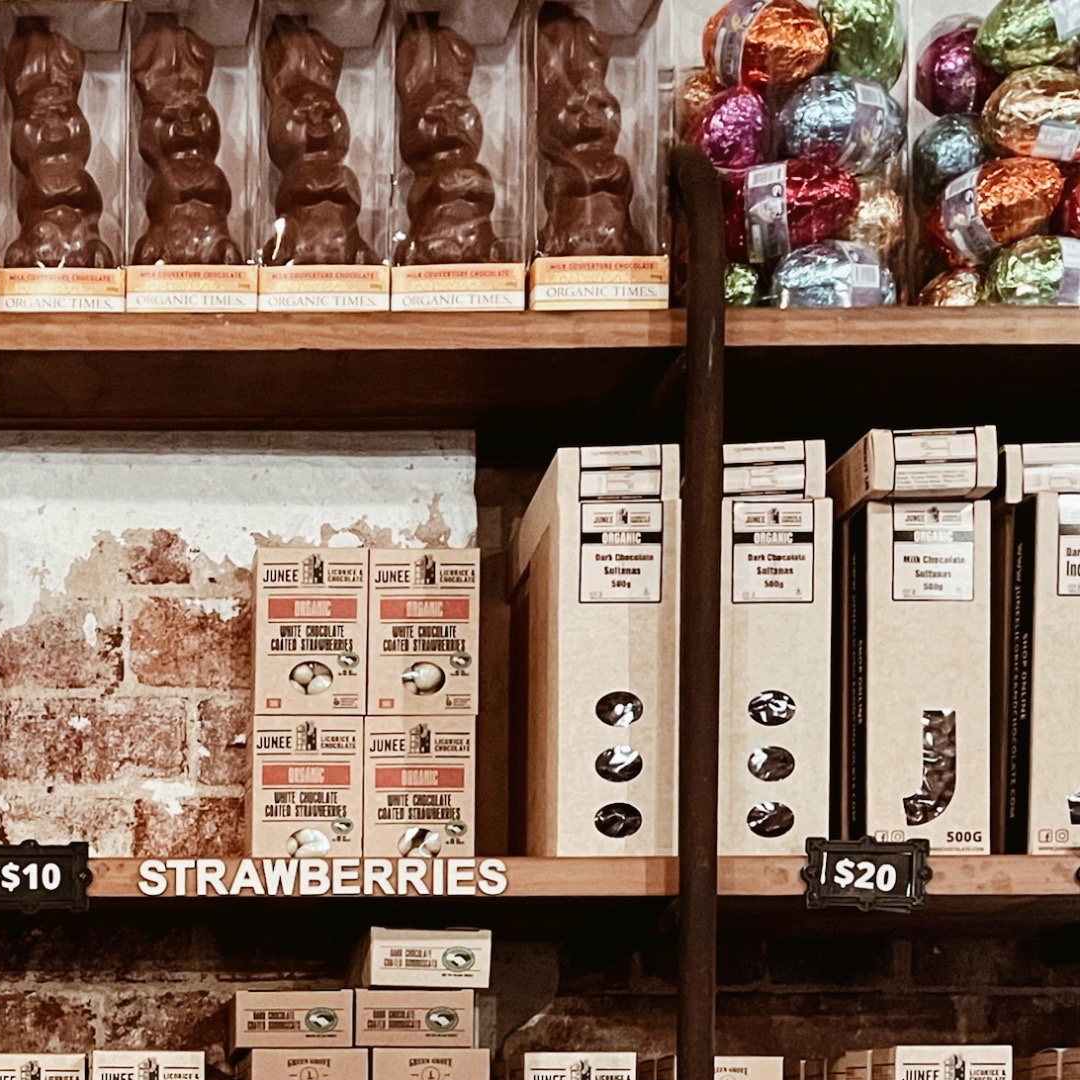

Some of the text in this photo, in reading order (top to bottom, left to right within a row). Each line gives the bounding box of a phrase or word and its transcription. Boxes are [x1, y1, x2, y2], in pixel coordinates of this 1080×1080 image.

[547, 286, 608, 297] ORGANIC
[602, 533, 641, 544] ORGANIC
[754, 532, 793, 544] ORGANIC
[914, 531, 953, 543] ORGANIC
[903, 556, 965, 564] Milk Chocolate
[263, 569, 298, 582] JUNEE
[604, 566, 641, 574] Sultanas
[757, 567, 793, 575] Sultanas
[915, 570, 951, 578] Sultanas
[375, 570, 410, 583] JUNEE
[765, 580, 784, 588] 500g
[280, 626, 344, 637] WHITE CHOCOLATE
[271, 639, 353, 651] COATED STRAWBERRIES
[257, 736, 292, 749] JUNEE
[370, 739, 405, 751] JUNEE
[946, 831, 982, 842] 500G
[0, 862, 62, 892] $10
[137, 858, 508, 897] STRAWBERRIES
[834, 858, 896, 892] $20
